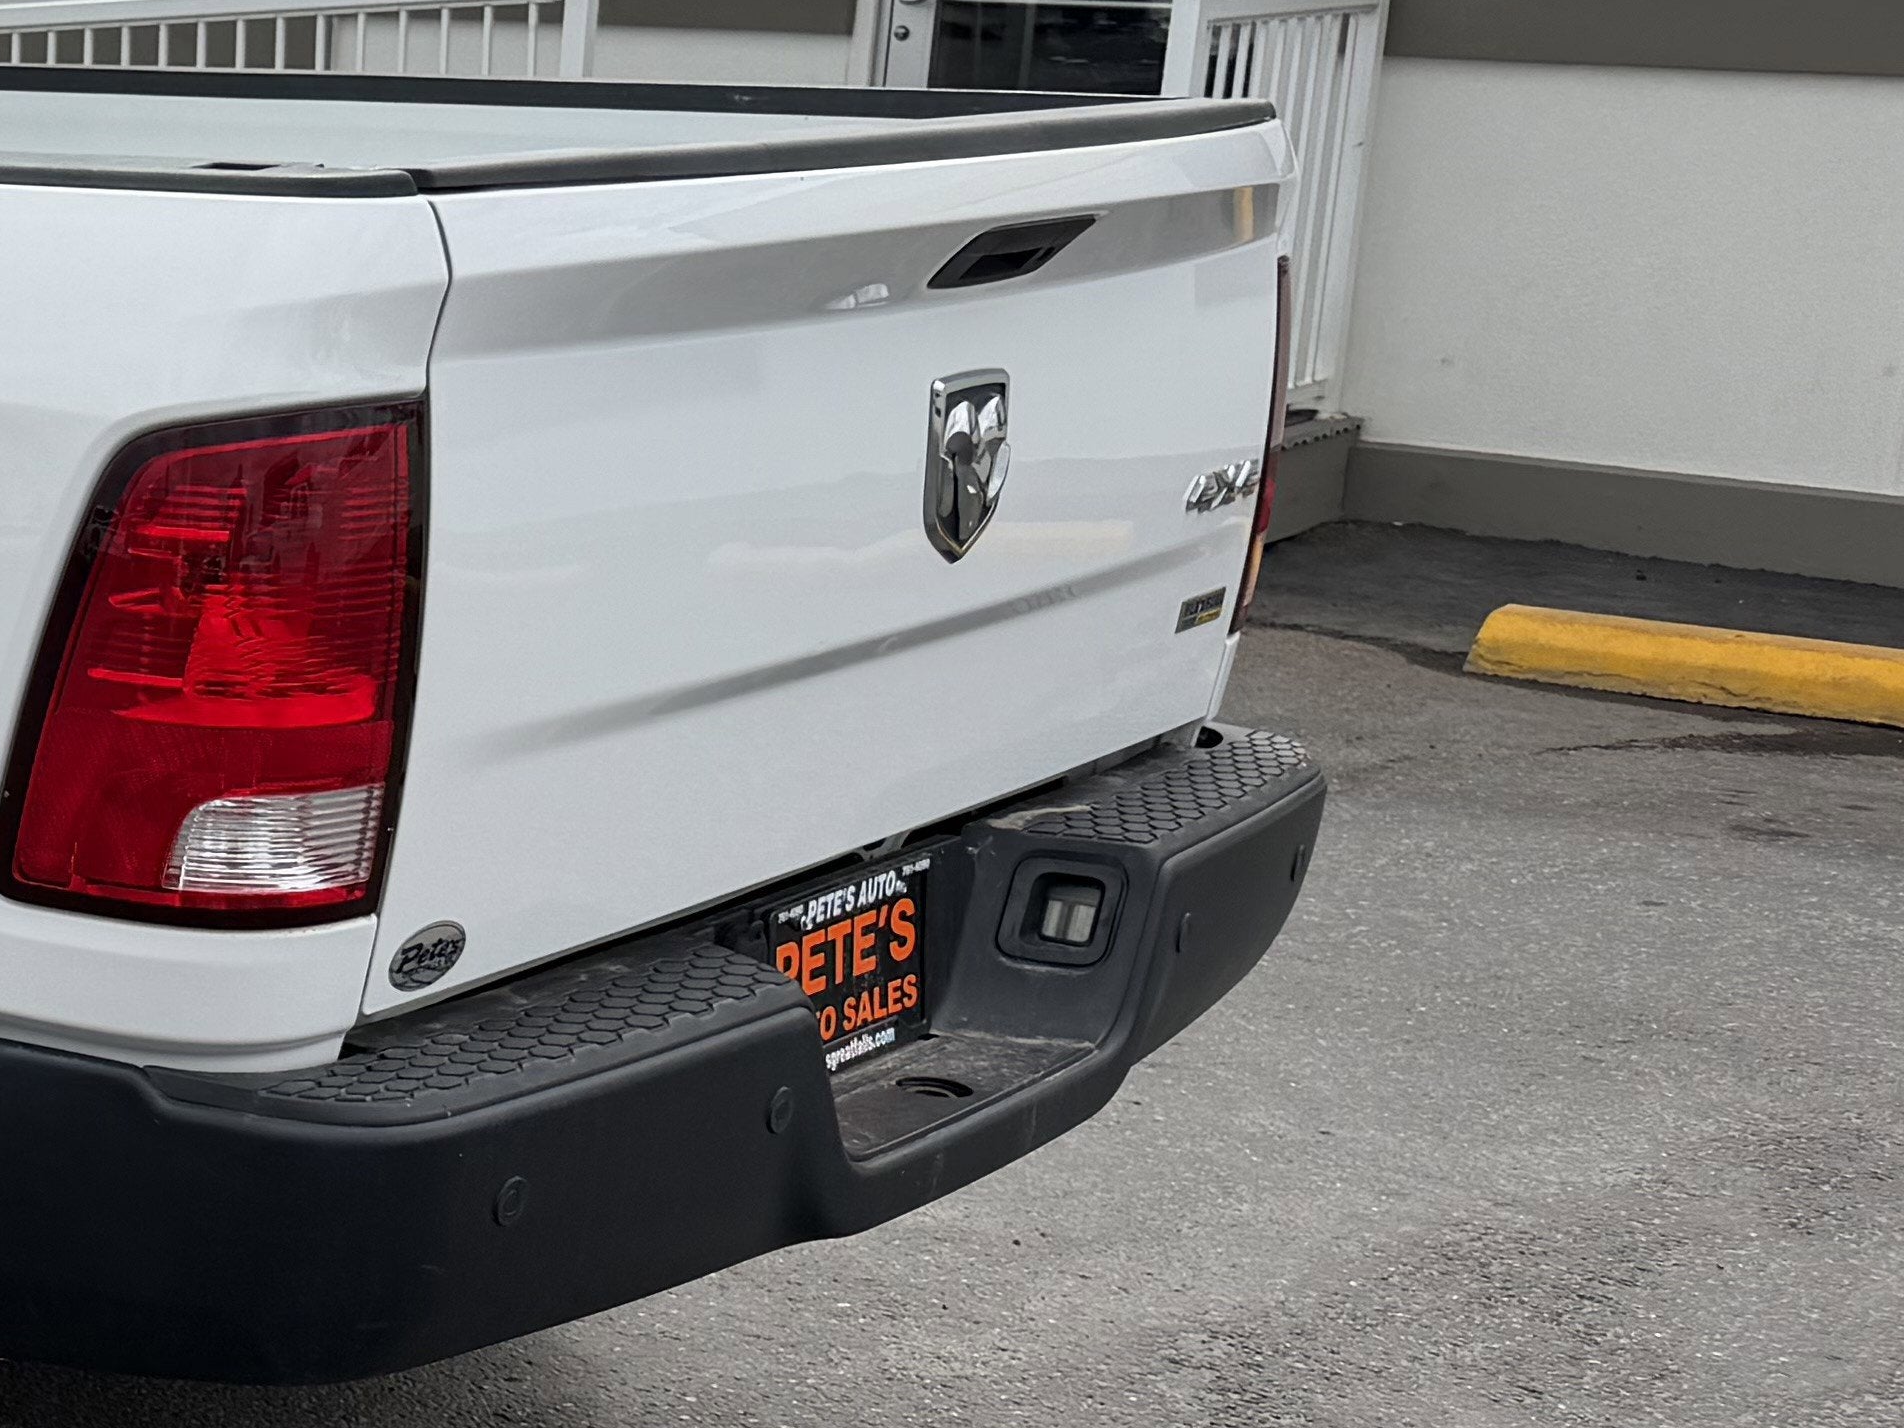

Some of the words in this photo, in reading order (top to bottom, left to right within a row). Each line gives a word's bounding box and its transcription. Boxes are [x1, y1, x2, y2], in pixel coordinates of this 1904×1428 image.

[806, 884, 857, 926] PETE'S
[856, 869, 897, 909] AUTO
[775, 897, 917, 996] PETE'S
[842, 973, 918, 1031] SALES
